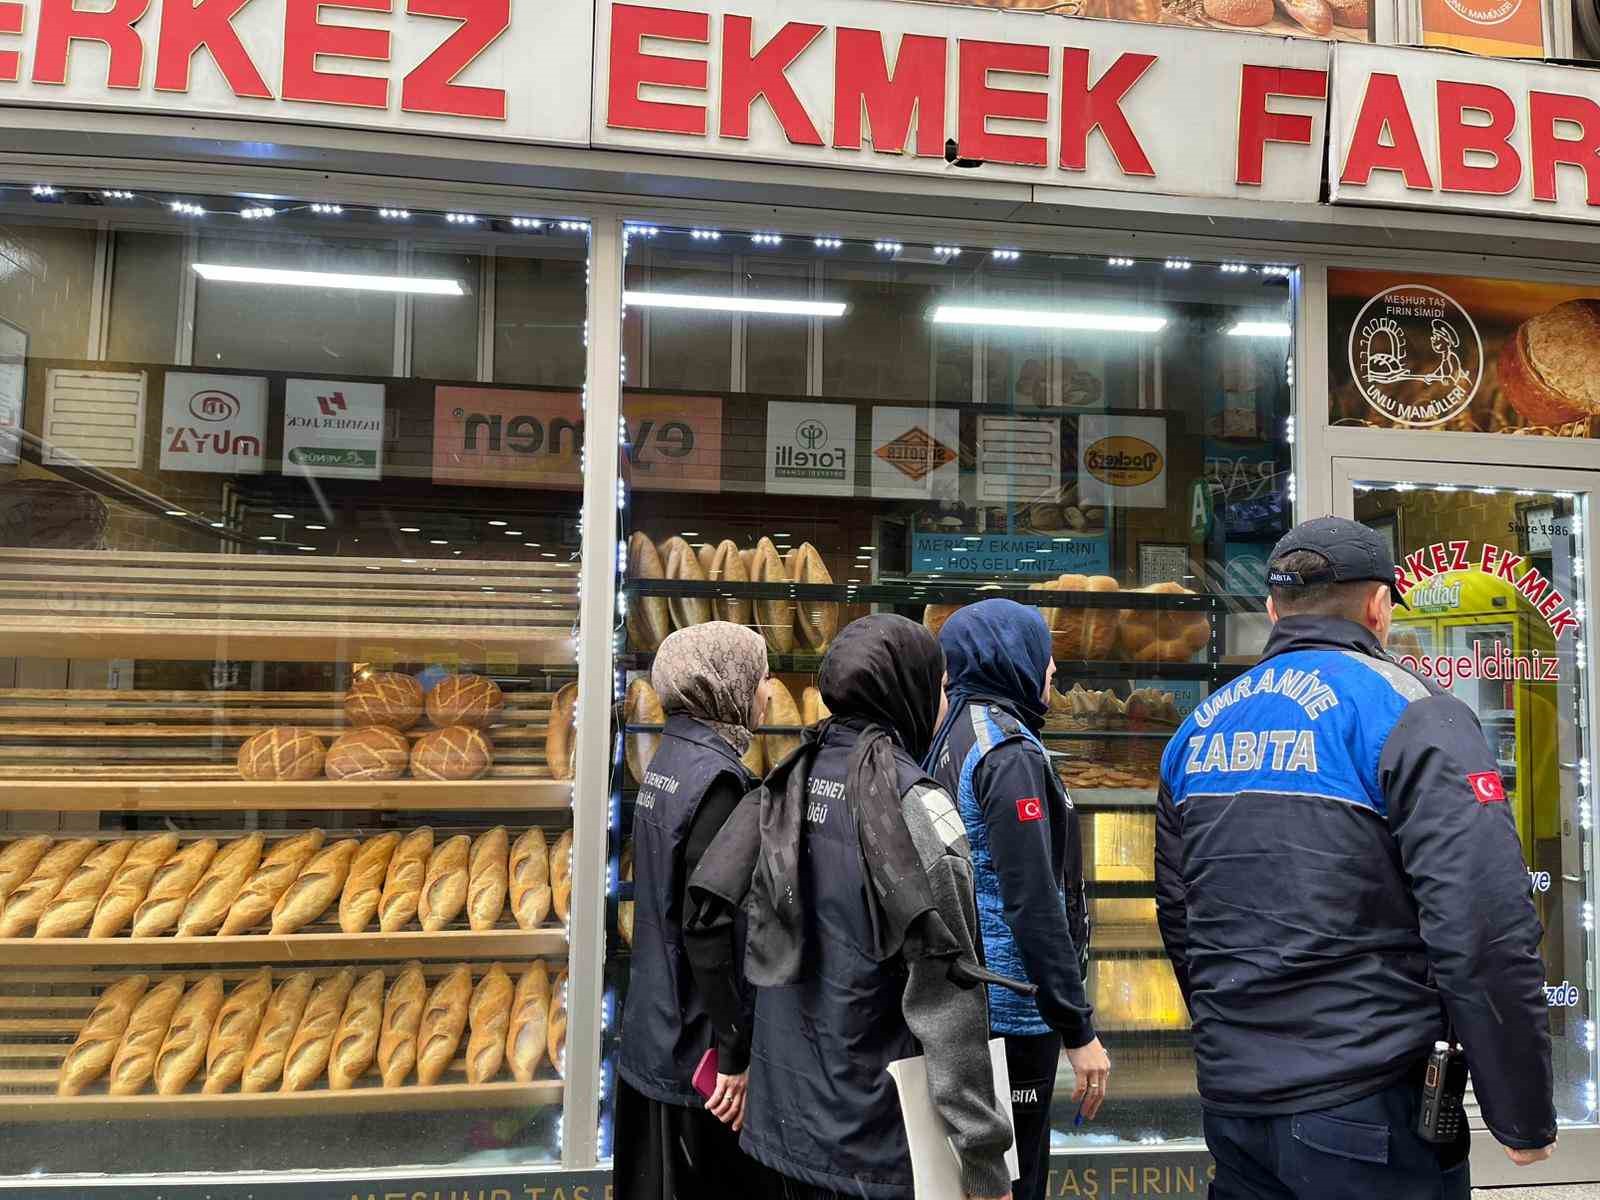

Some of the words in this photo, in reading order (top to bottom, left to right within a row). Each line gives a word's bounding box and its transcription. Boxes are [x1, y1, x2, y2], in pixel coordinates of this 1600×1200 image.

[0, 0, 511, 121] RKEZ
[606, 3, 1160, 177] EKMEK
[1386, 306, 1412, 317] FIRIN
[1366, 384, 1396, 411] UNLU
[1508, 522, 1537, 535] Since
[1541, 524, 1569, 536] 1986
[1391, 541, 1471, 608] RKEZ
[1480, 543, 1579, 640] EKMEK
[1186, 729, 1318, 775] ZABITA
[812, 779, 846, 801] DENET
[1528, 867, 1551, 894] ye
[1543, 981, 1579, 1007] zde
[1111, 1165, 1195, 1195] FIRIN
